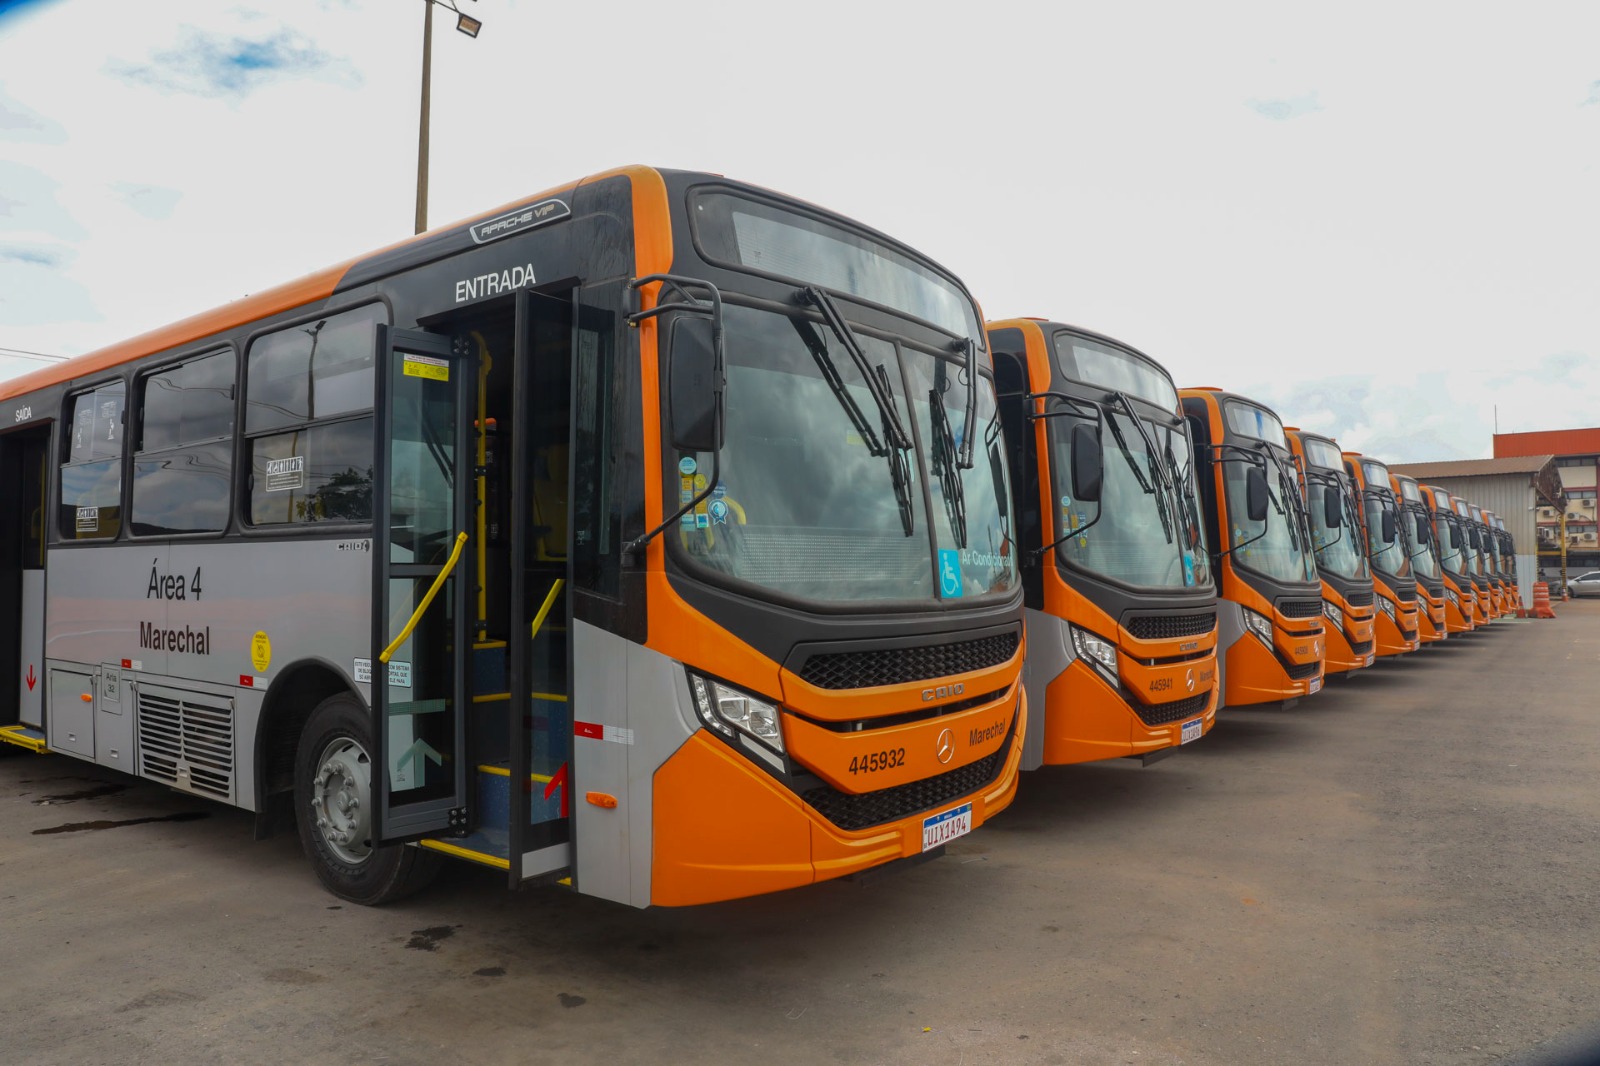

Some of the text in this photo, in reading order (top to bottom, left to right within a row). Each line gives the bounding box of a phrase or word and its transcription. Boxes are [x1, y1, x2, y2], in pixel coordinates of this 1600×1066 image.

[481, 203, 555, 236] APACHE VIP
[455, 262, 537, 303] ENTRADA
[15, 404, 32, 422] SAÍDA
[962, 550, 971, 566] Ar
[147, 558, 202, 601] Área 4
[140, 621, 210, 656] Marechal
[108, 684, 115, 693] 32
[922, 683, 965, 702] CAIO
[1149, 677, 1173, 692] 445941
[848, 718, 1006, 775] 445932 Marechal
[927, 815, 967, 846] UIX1A94
